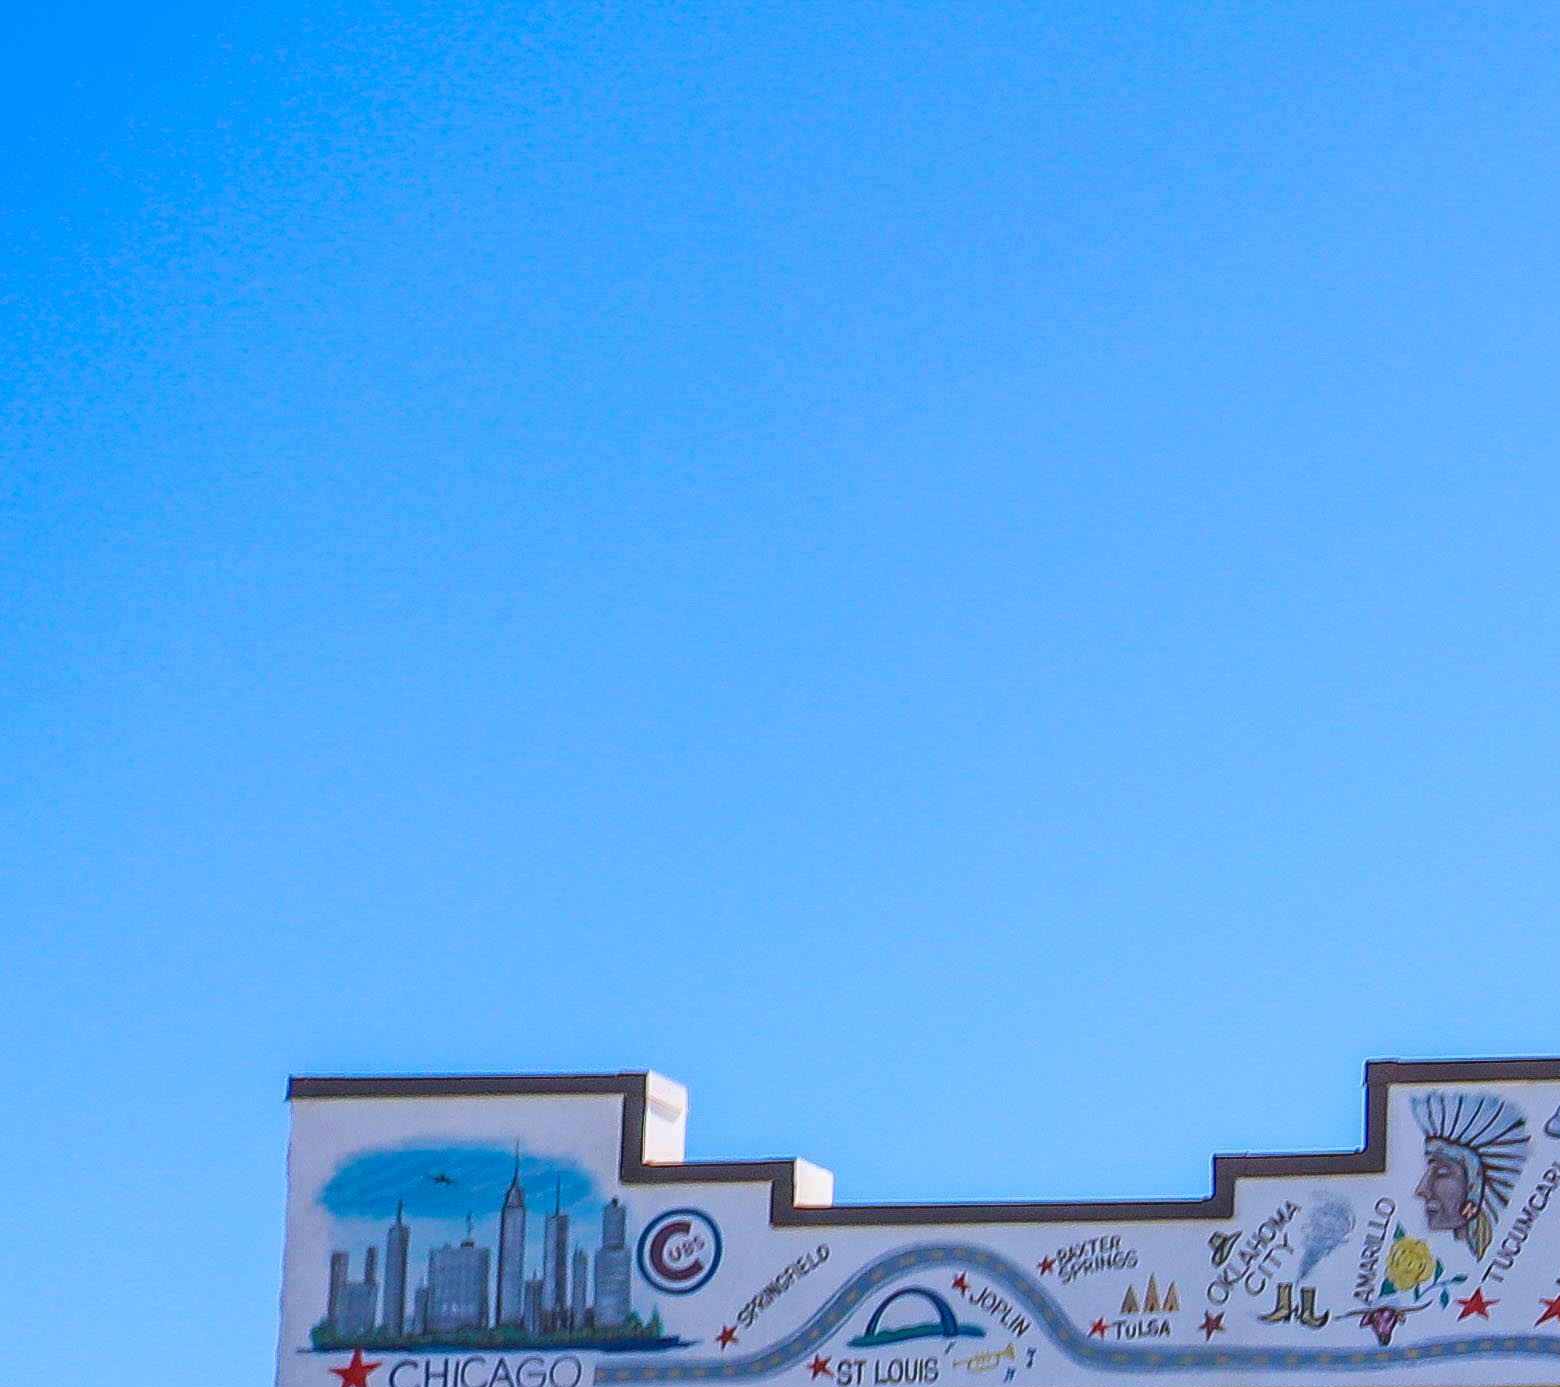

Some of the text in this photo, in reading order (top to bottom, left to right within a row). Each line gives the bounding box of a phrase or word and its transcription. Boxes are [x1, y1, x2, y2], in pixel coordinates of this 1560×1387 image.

[1207, 1200, 1302, 1304] OKLAHOMA
[1244, 1231, 1296, 1296] CITY
[1353, 1197, 1398, 1302] AMARILLO
[737, 1243, 830, 1327] SPRINGFIELD
[968, 1286, 1031, 1338] JOPLIN
[1112, 1318, 1171, 1340] TULSA
[836, 1358, 940, 1387] ST LOUIS
